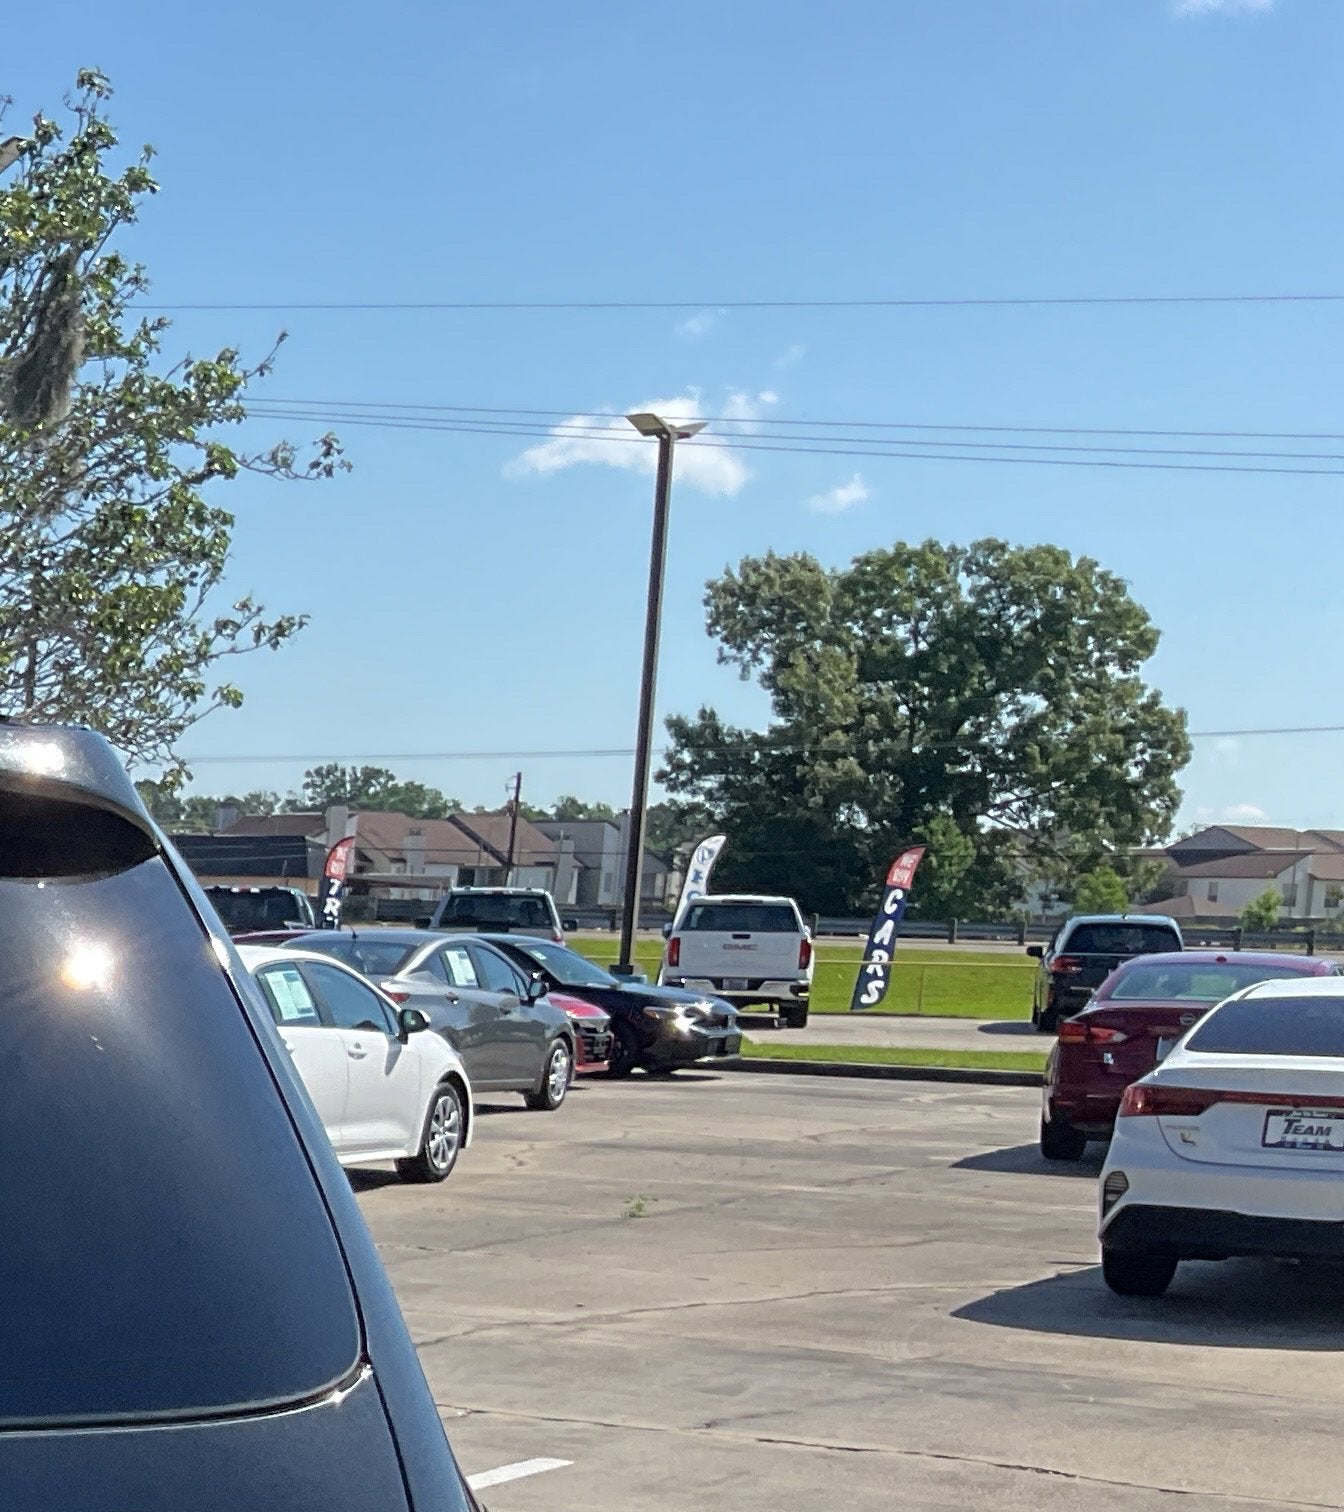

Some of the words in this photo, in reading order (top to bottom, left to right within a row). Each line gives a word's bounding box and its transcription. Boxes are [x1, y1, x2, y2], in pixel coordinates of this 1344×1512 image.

[722, 943, 758, 951] GMC
[860, 889, 903, 1004] CARS
[1284, 1118, 1332, 1136] TEAM
